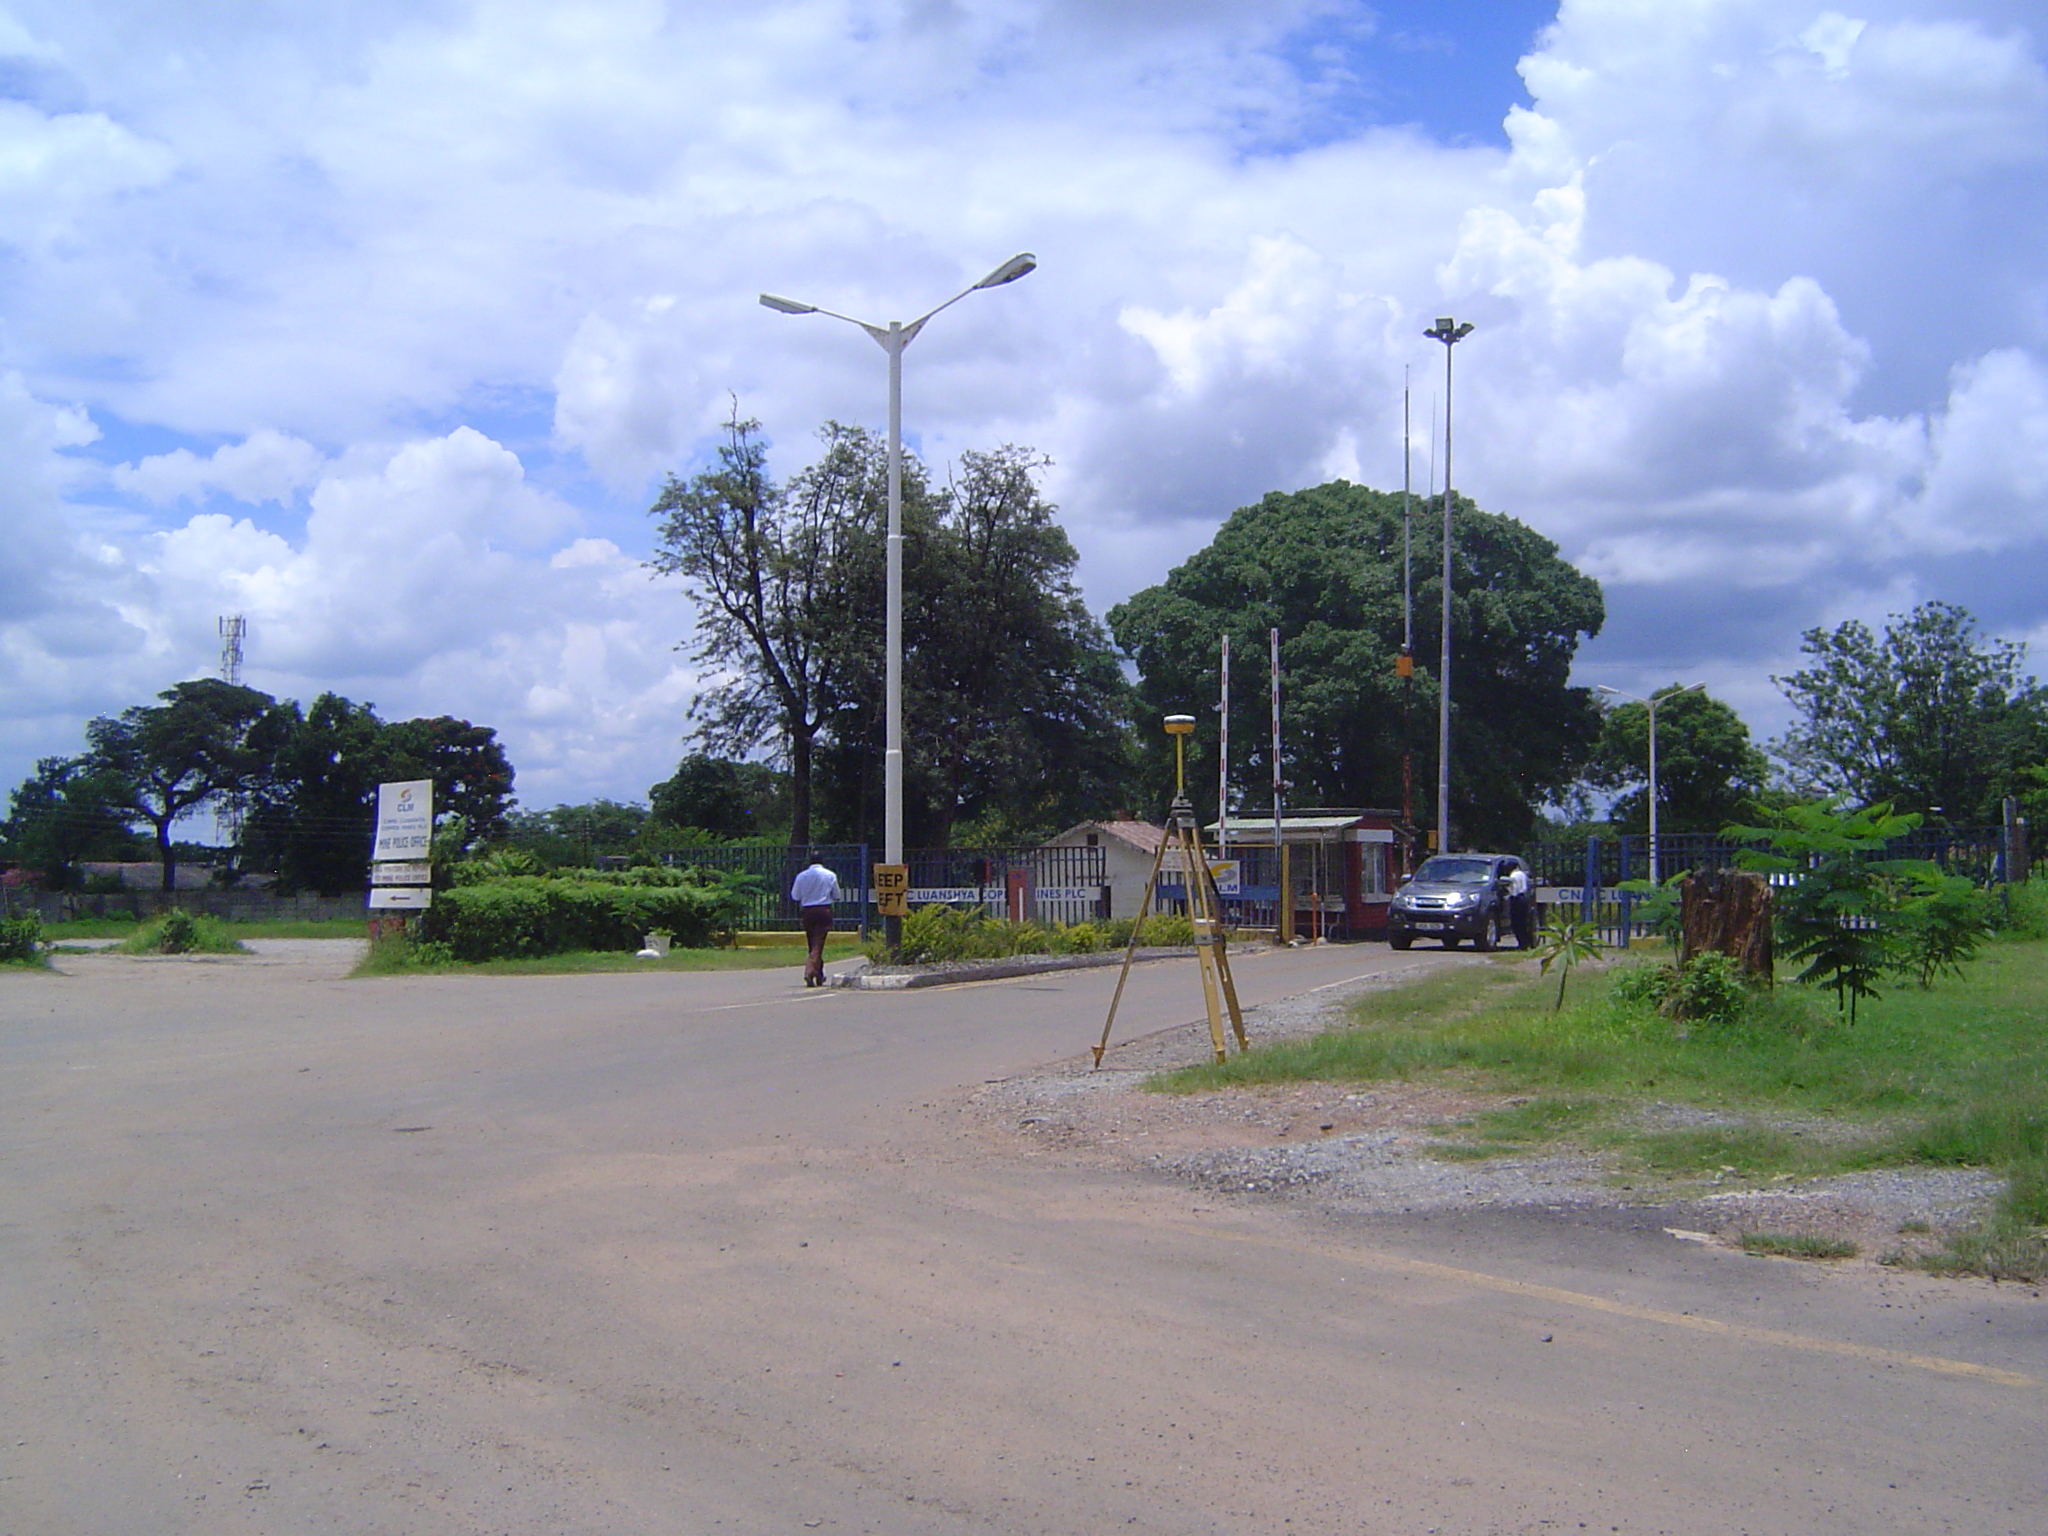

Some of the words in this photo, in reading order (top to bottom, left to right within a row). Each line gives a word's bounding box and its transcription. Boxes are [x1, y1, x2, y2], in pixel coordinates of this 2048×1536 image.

[878, 873, 903, 887] EEP
[917, 889, 975, 900] LUANSHYA
[982, 889, 1006, 900] COP
[1037, 889, 1061, 899] INES
[1065, 888, 1086, 899] PLC
[1219, 884, 1238, 892] LM
[879, 892, 904, 906] EFT
[1558, 889, 1606, 900] CNC
